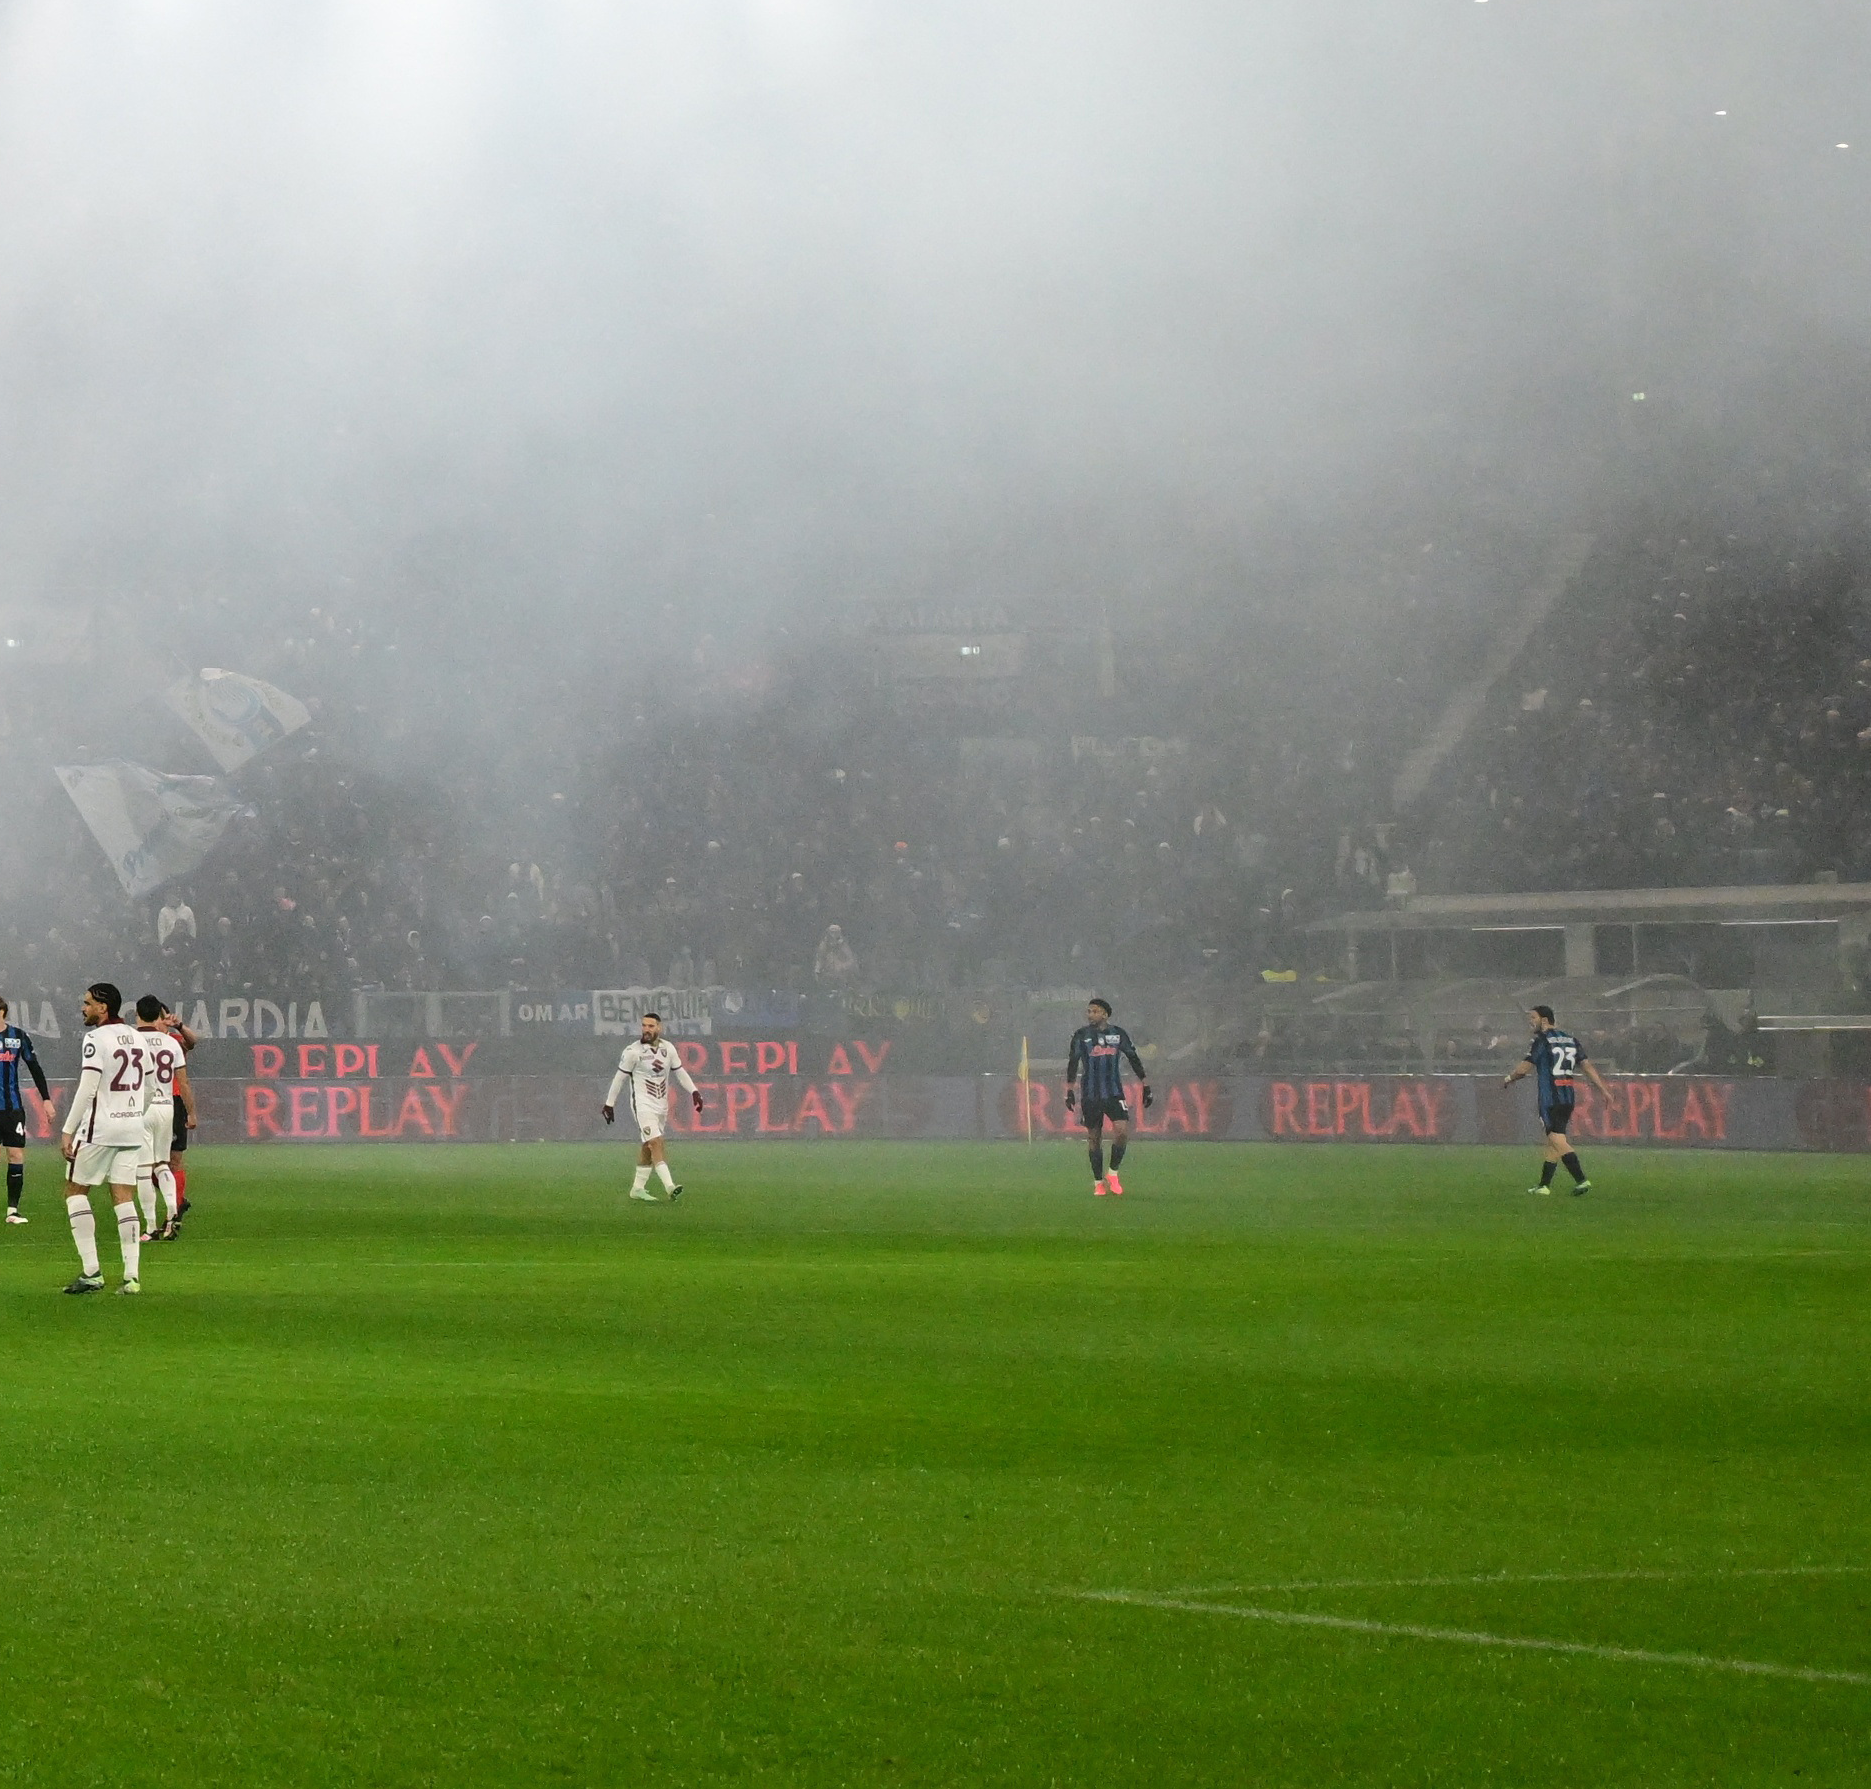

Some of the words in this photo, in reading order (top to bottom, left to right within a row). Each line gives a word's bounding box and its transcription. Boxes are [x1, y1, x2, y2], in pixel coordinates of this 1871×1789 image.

[119, 999, 329, 1039] ARDIA
[146, 1037, 163, 1047] ICCI
[1552, 1047, 1577, 1076] 23
[110, 1048, 144, 1092] 23
[149, 1049, 175, 1084] 8
[243, 1082, 470, 1139] REPLAY
[1014, 1079, 1218, 1135] RLAY
[1271, 1081, 1447, 1138] REPLAY
